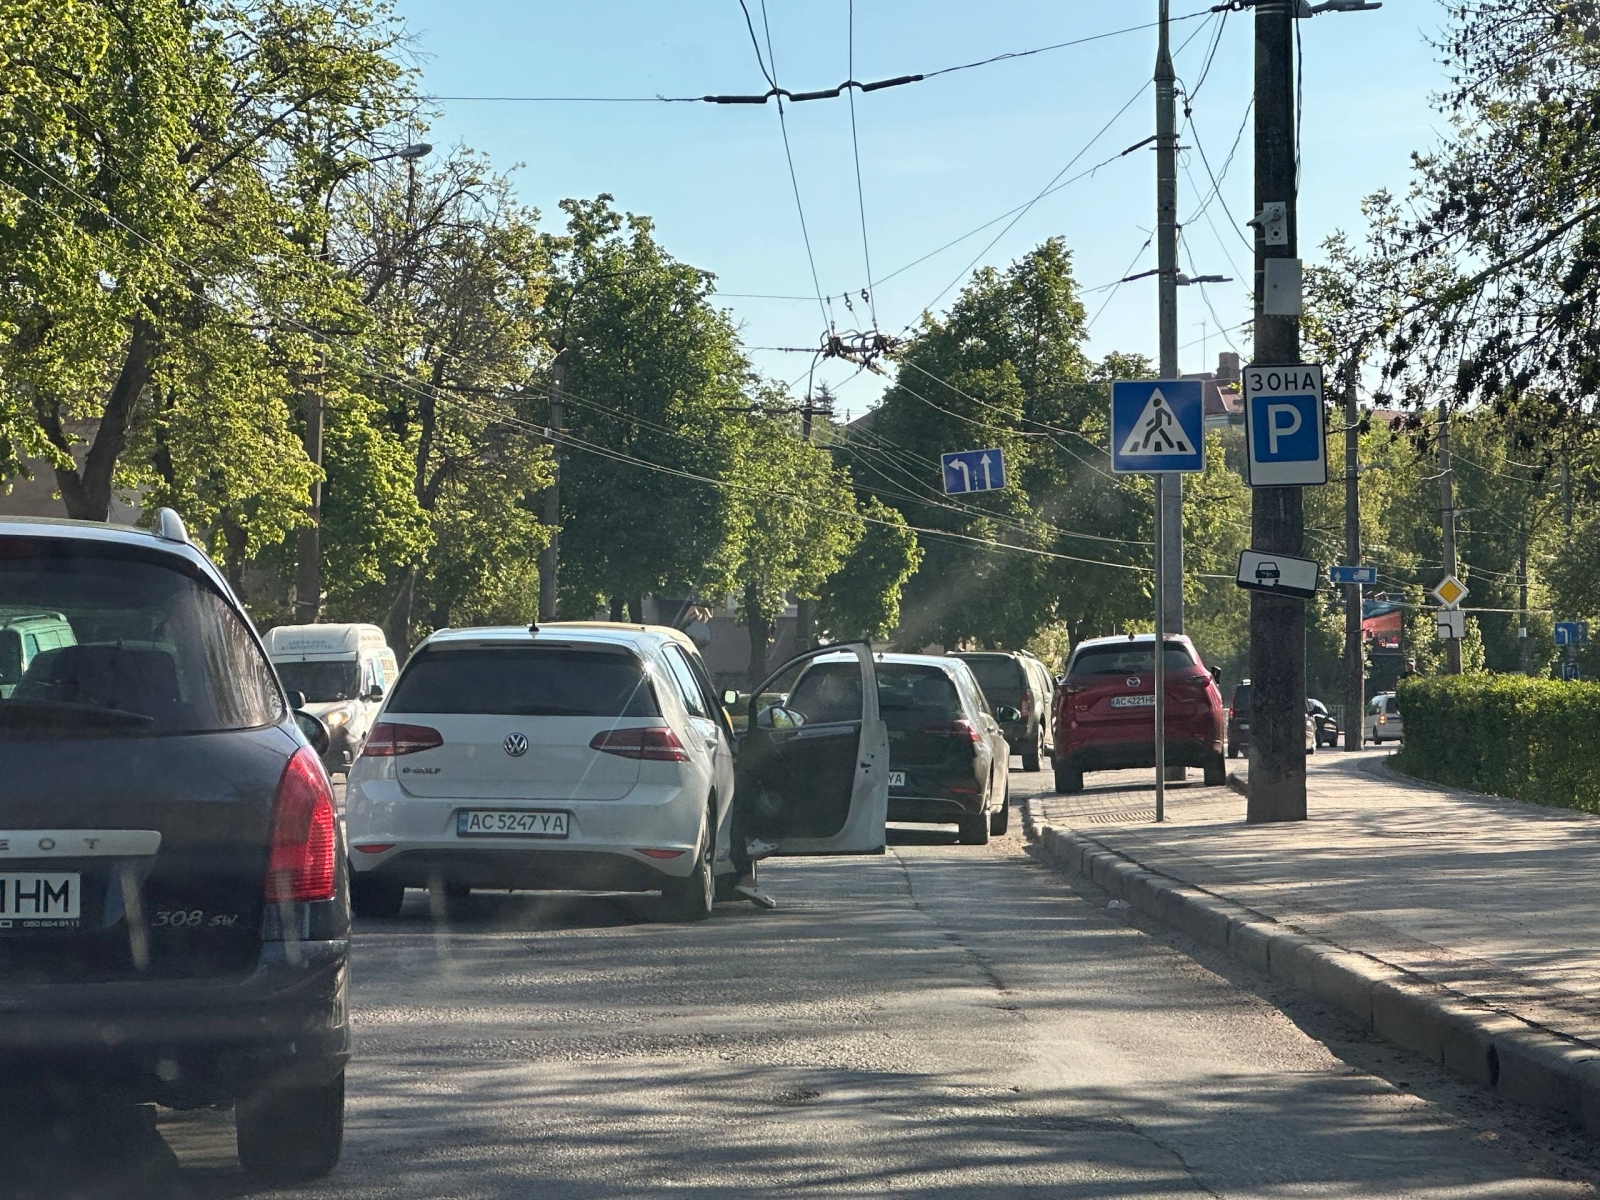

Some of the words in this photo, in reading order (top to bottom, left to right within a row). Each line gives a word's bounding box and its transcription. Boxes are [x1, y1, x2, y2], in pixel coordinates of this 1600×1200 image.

[1250, 372, 1316, 392] ЗОНА
[1267, 403, 1302, 454] P
[469, 813, 495, 831] AC
[497, 814, 537, 832] 5247
[152, 910, 203, 927] 308
